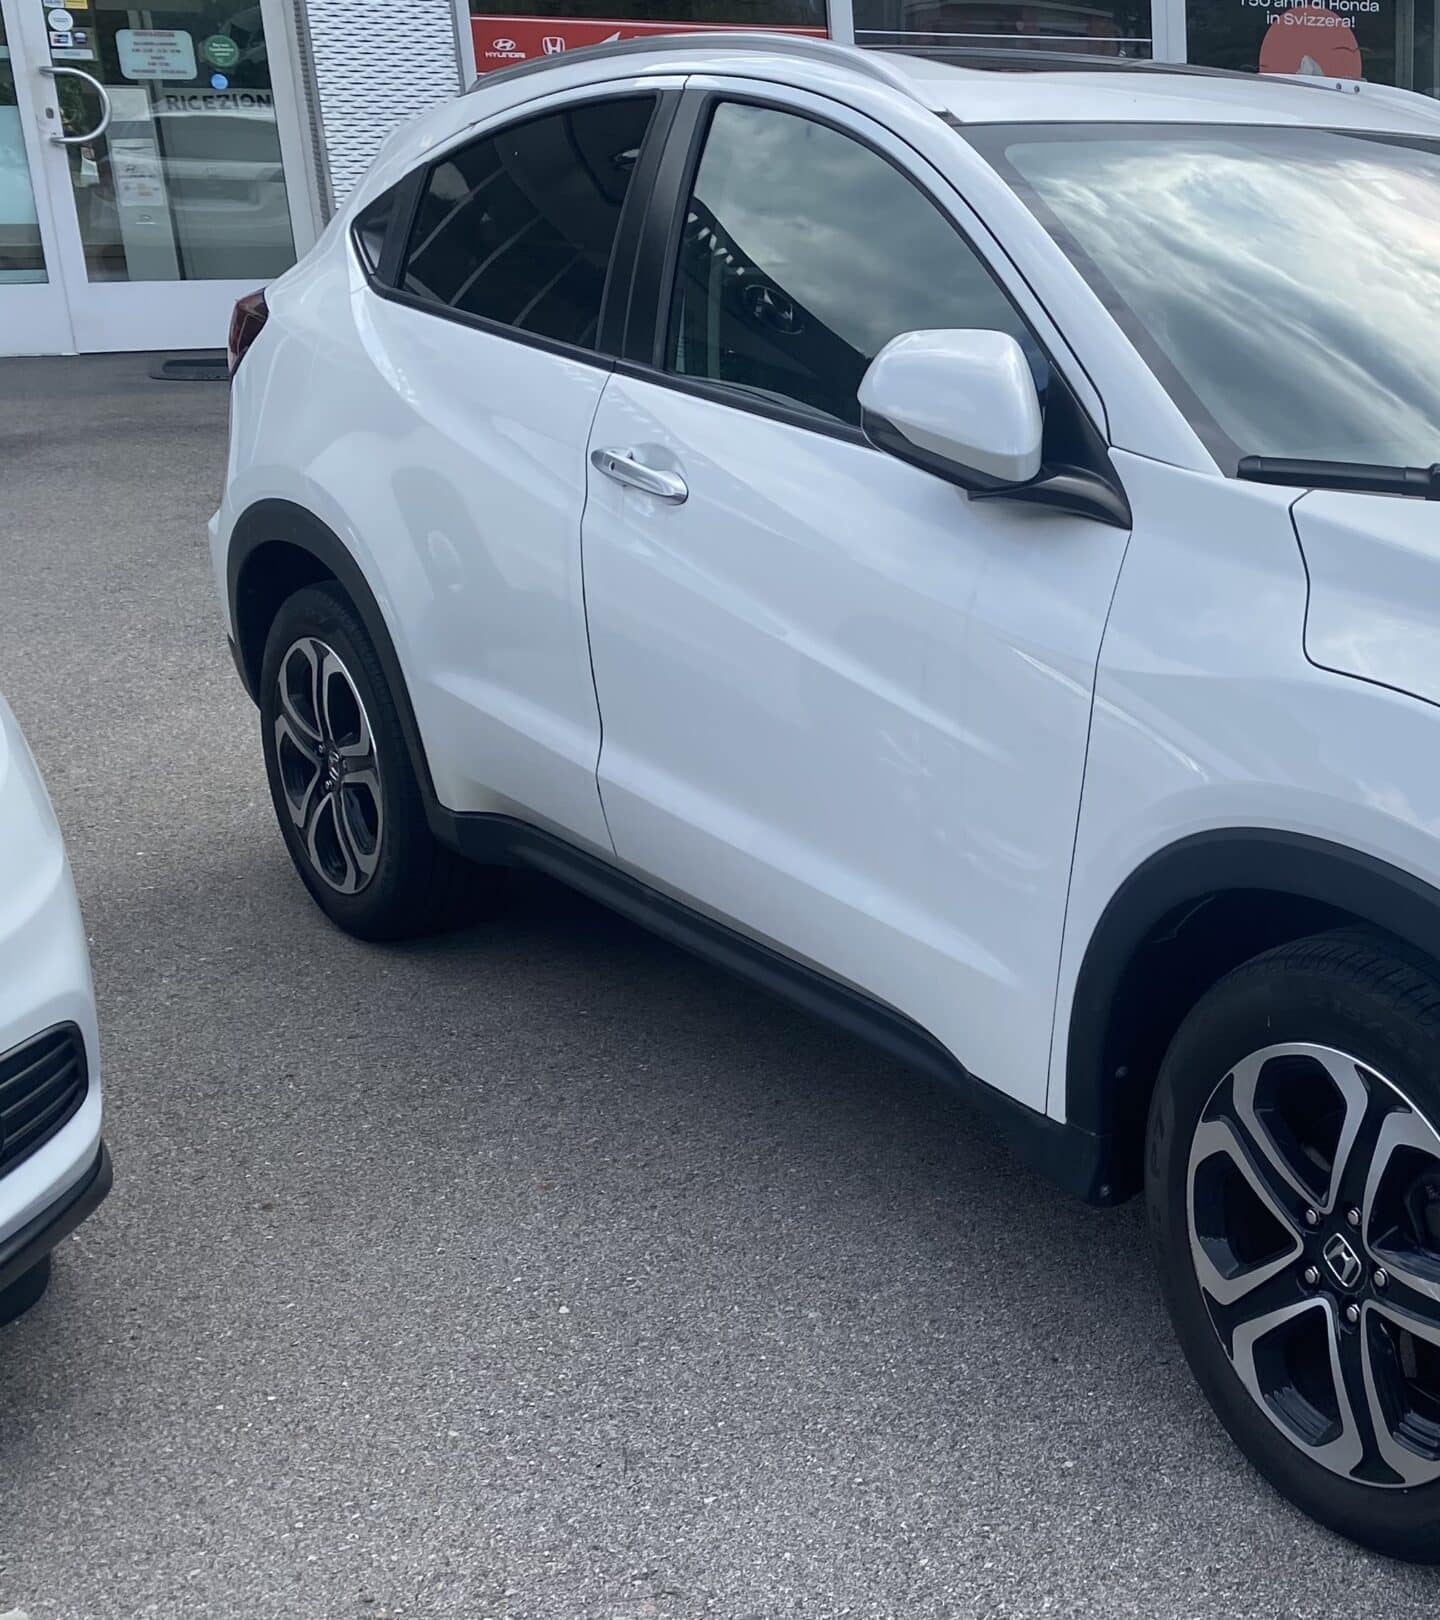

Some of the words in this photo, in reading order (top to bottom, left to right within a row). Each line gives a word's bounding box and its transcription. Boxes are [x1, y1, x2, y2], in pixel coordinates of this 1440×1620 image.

[1329, 0, 1379, 12] Honda
[1266, 10, 1280, 25] in
[1284, 12, 1355, 28] Svizzera!
[485, 51, 526, 59] HYUNDAI
